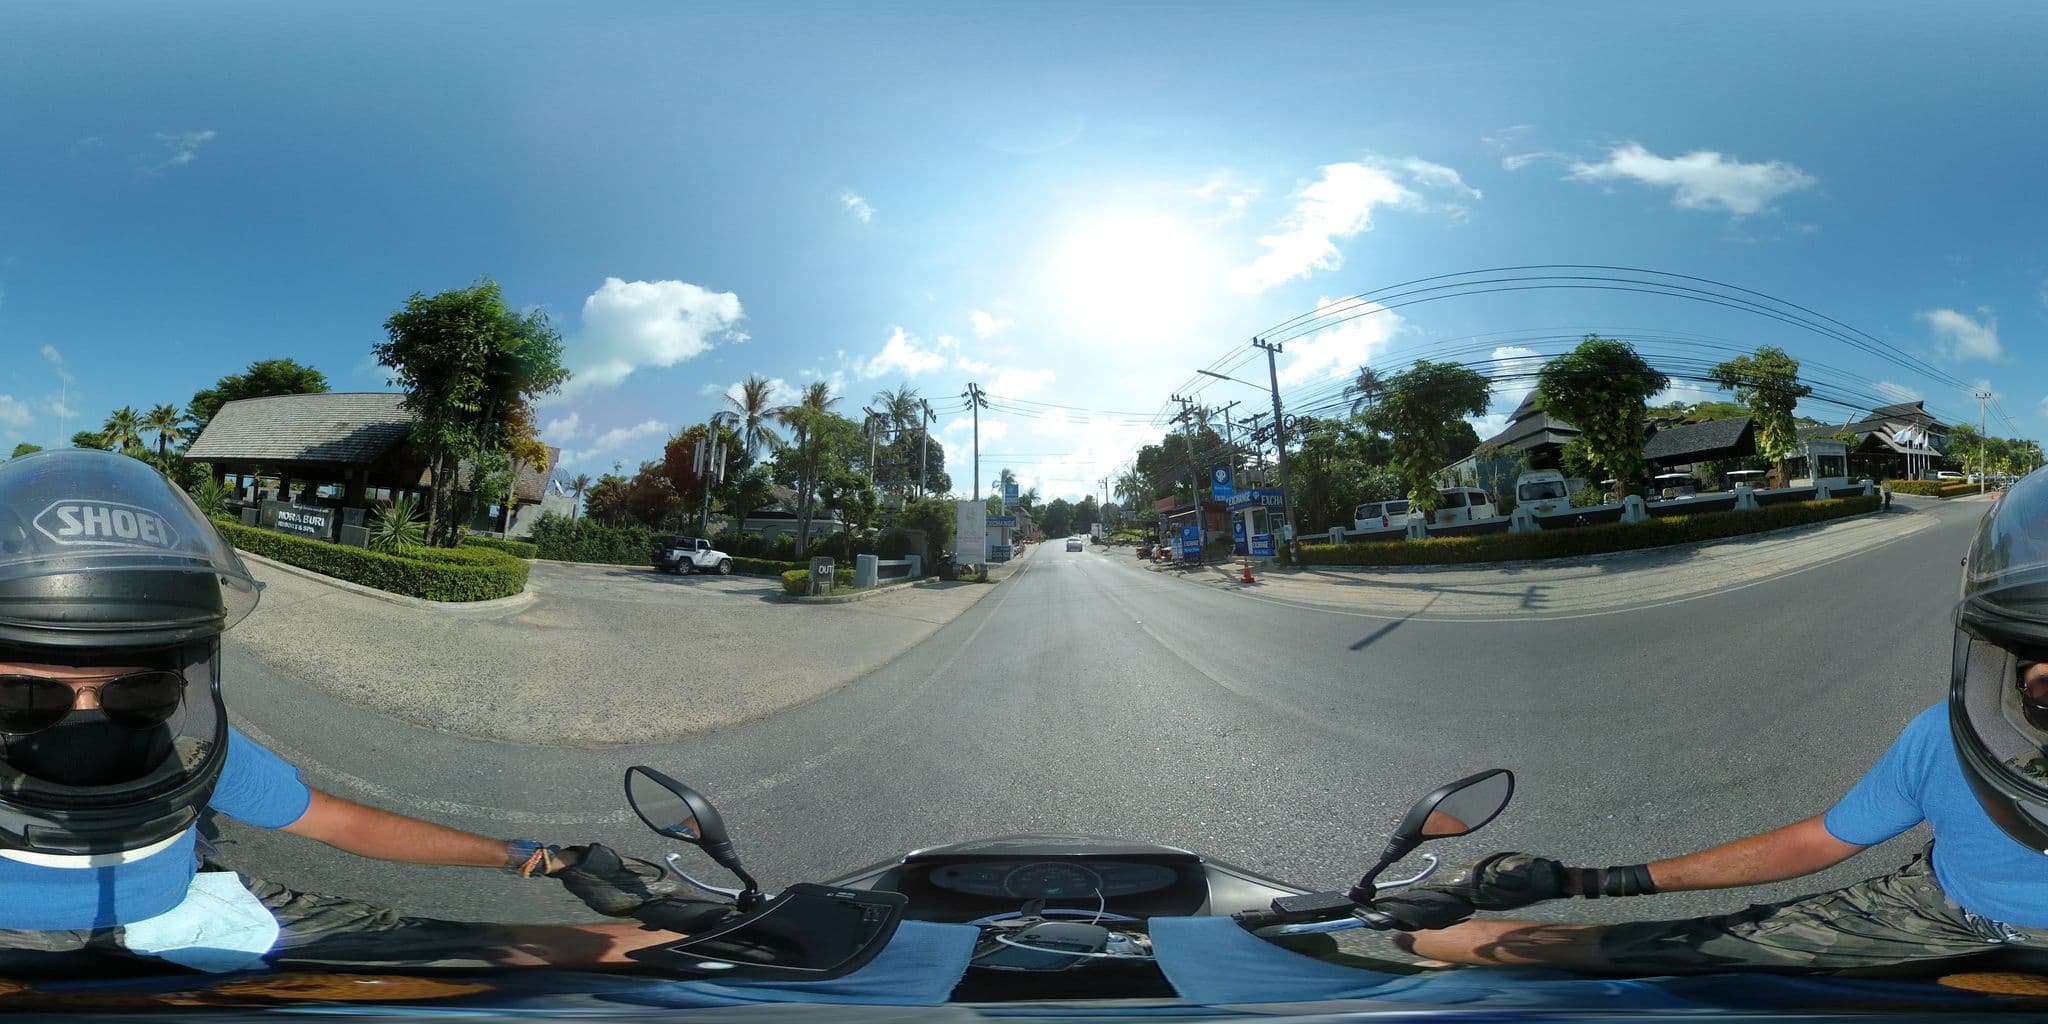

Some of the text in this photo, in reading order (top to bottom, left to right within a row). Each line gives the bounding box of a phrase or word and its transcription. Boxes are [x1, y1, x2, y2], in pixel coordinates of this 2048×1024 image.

[57, 506, 168, 546] SHOEI
[278, 511, 325, 527] NORA BURI
[818, 565, 834, 575] OUT
